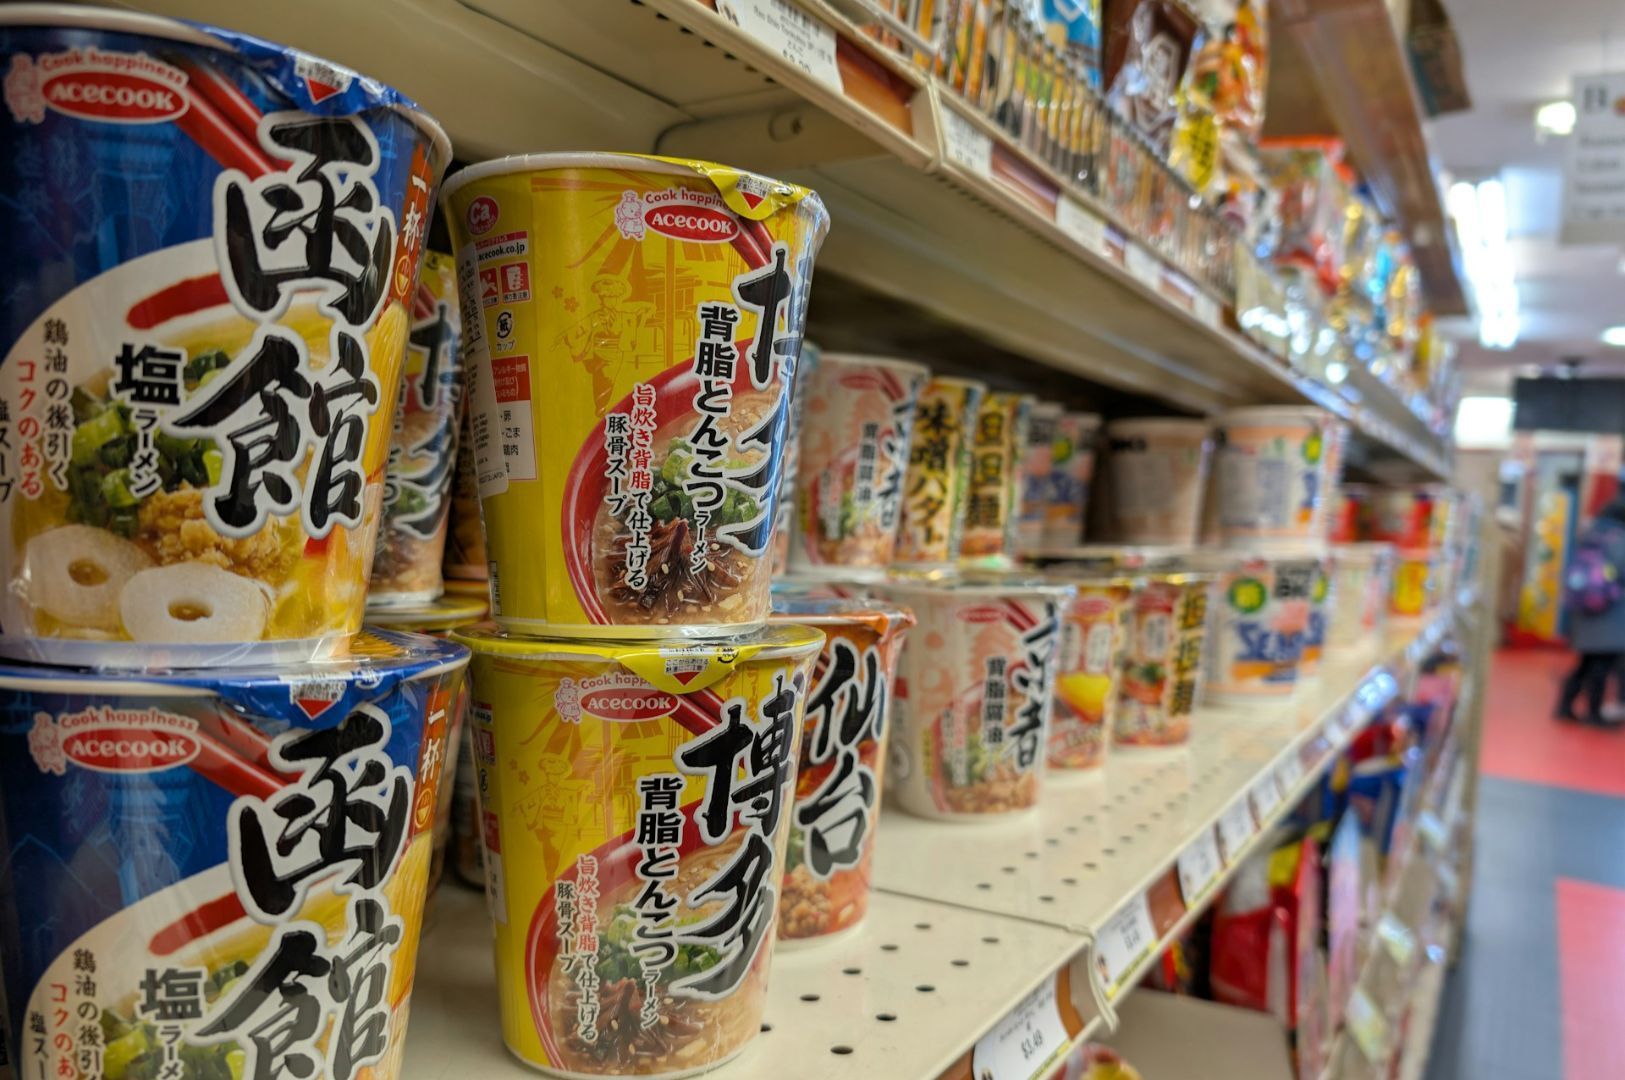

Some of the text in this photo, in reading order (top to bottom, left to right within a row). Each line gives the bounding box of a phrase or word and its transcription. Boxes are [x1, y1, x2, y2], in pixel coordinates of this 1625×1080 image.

[645, 191, 677, 205] Cook
[17, 360, 41, 496] コクのある
[607, 416, 629, 516] 豚骨スープ
[60, 709, 197, 730] Cook happiness
[580, 673, 651, 690] Cook happ
[799, 644, 885, 876] 仙台
[557, 883, 575, 971] 豚骨スープ
